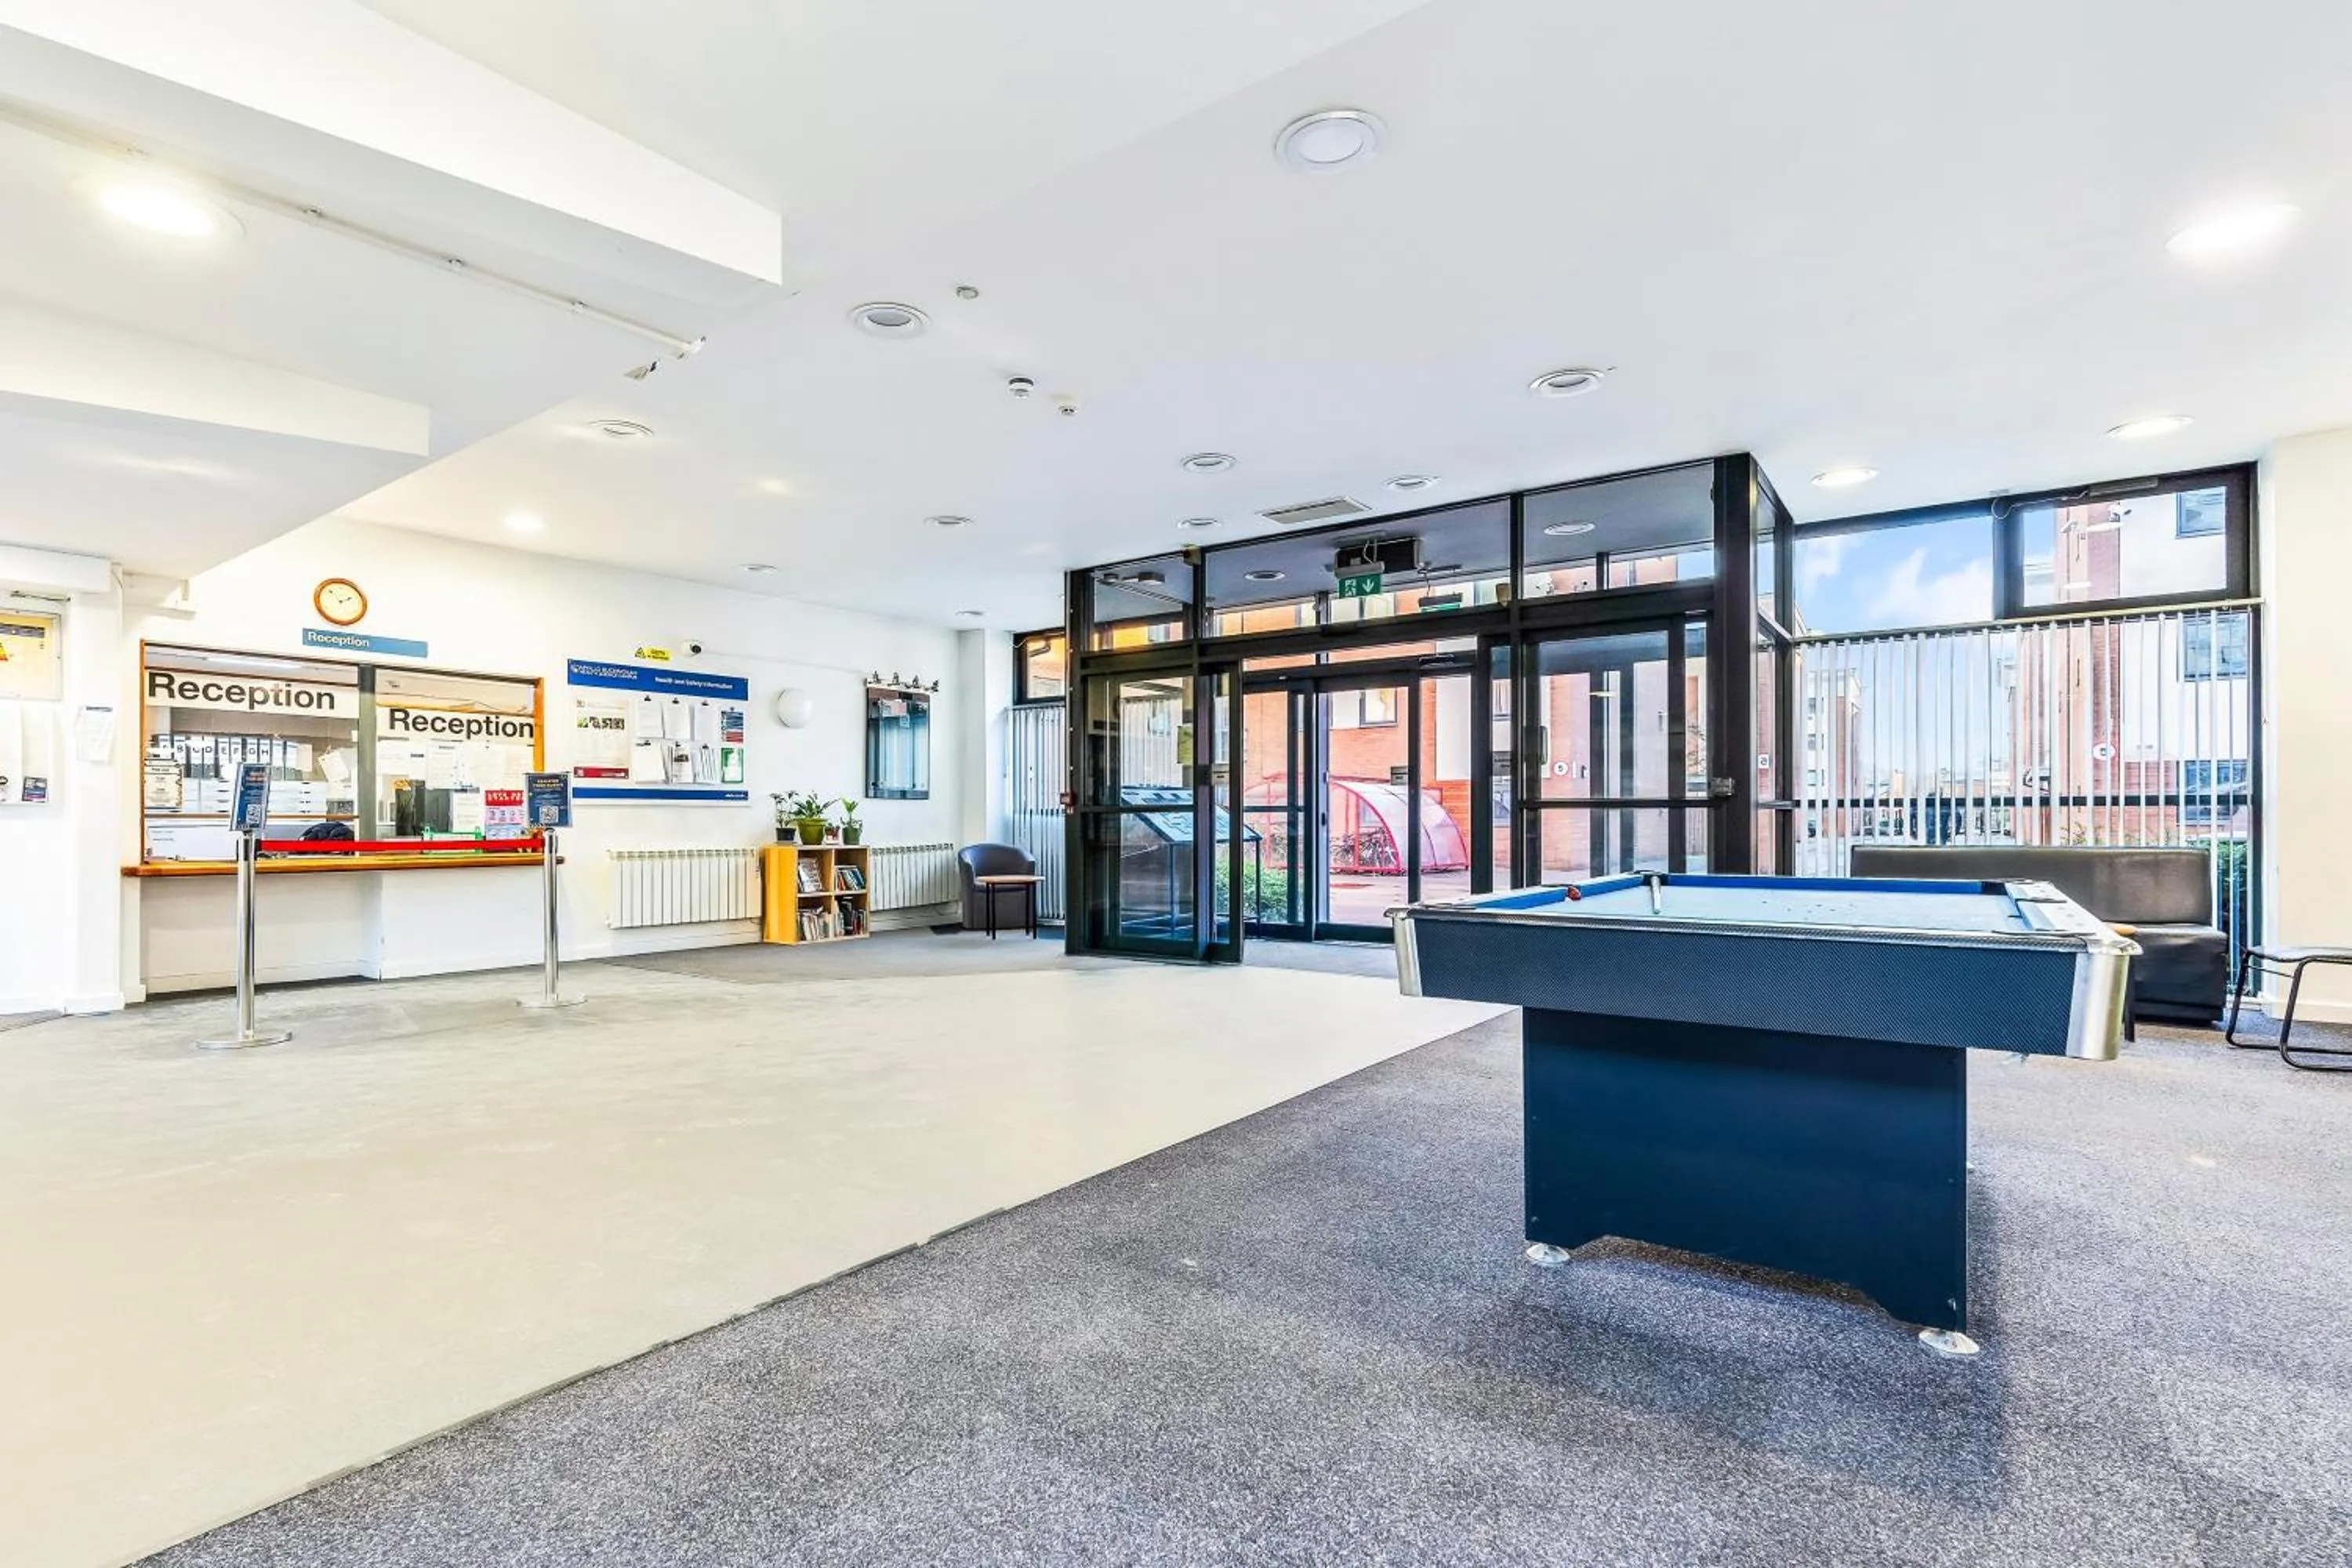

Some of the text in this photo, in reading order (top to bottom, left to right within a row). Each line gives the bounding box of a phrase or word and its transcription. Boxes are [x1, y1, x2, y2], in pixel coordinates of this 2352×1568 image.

[307, 631, 369, 648] Reception
[147, 671, 336, 710] Reception
[389, 708, 534, 739] Reception
